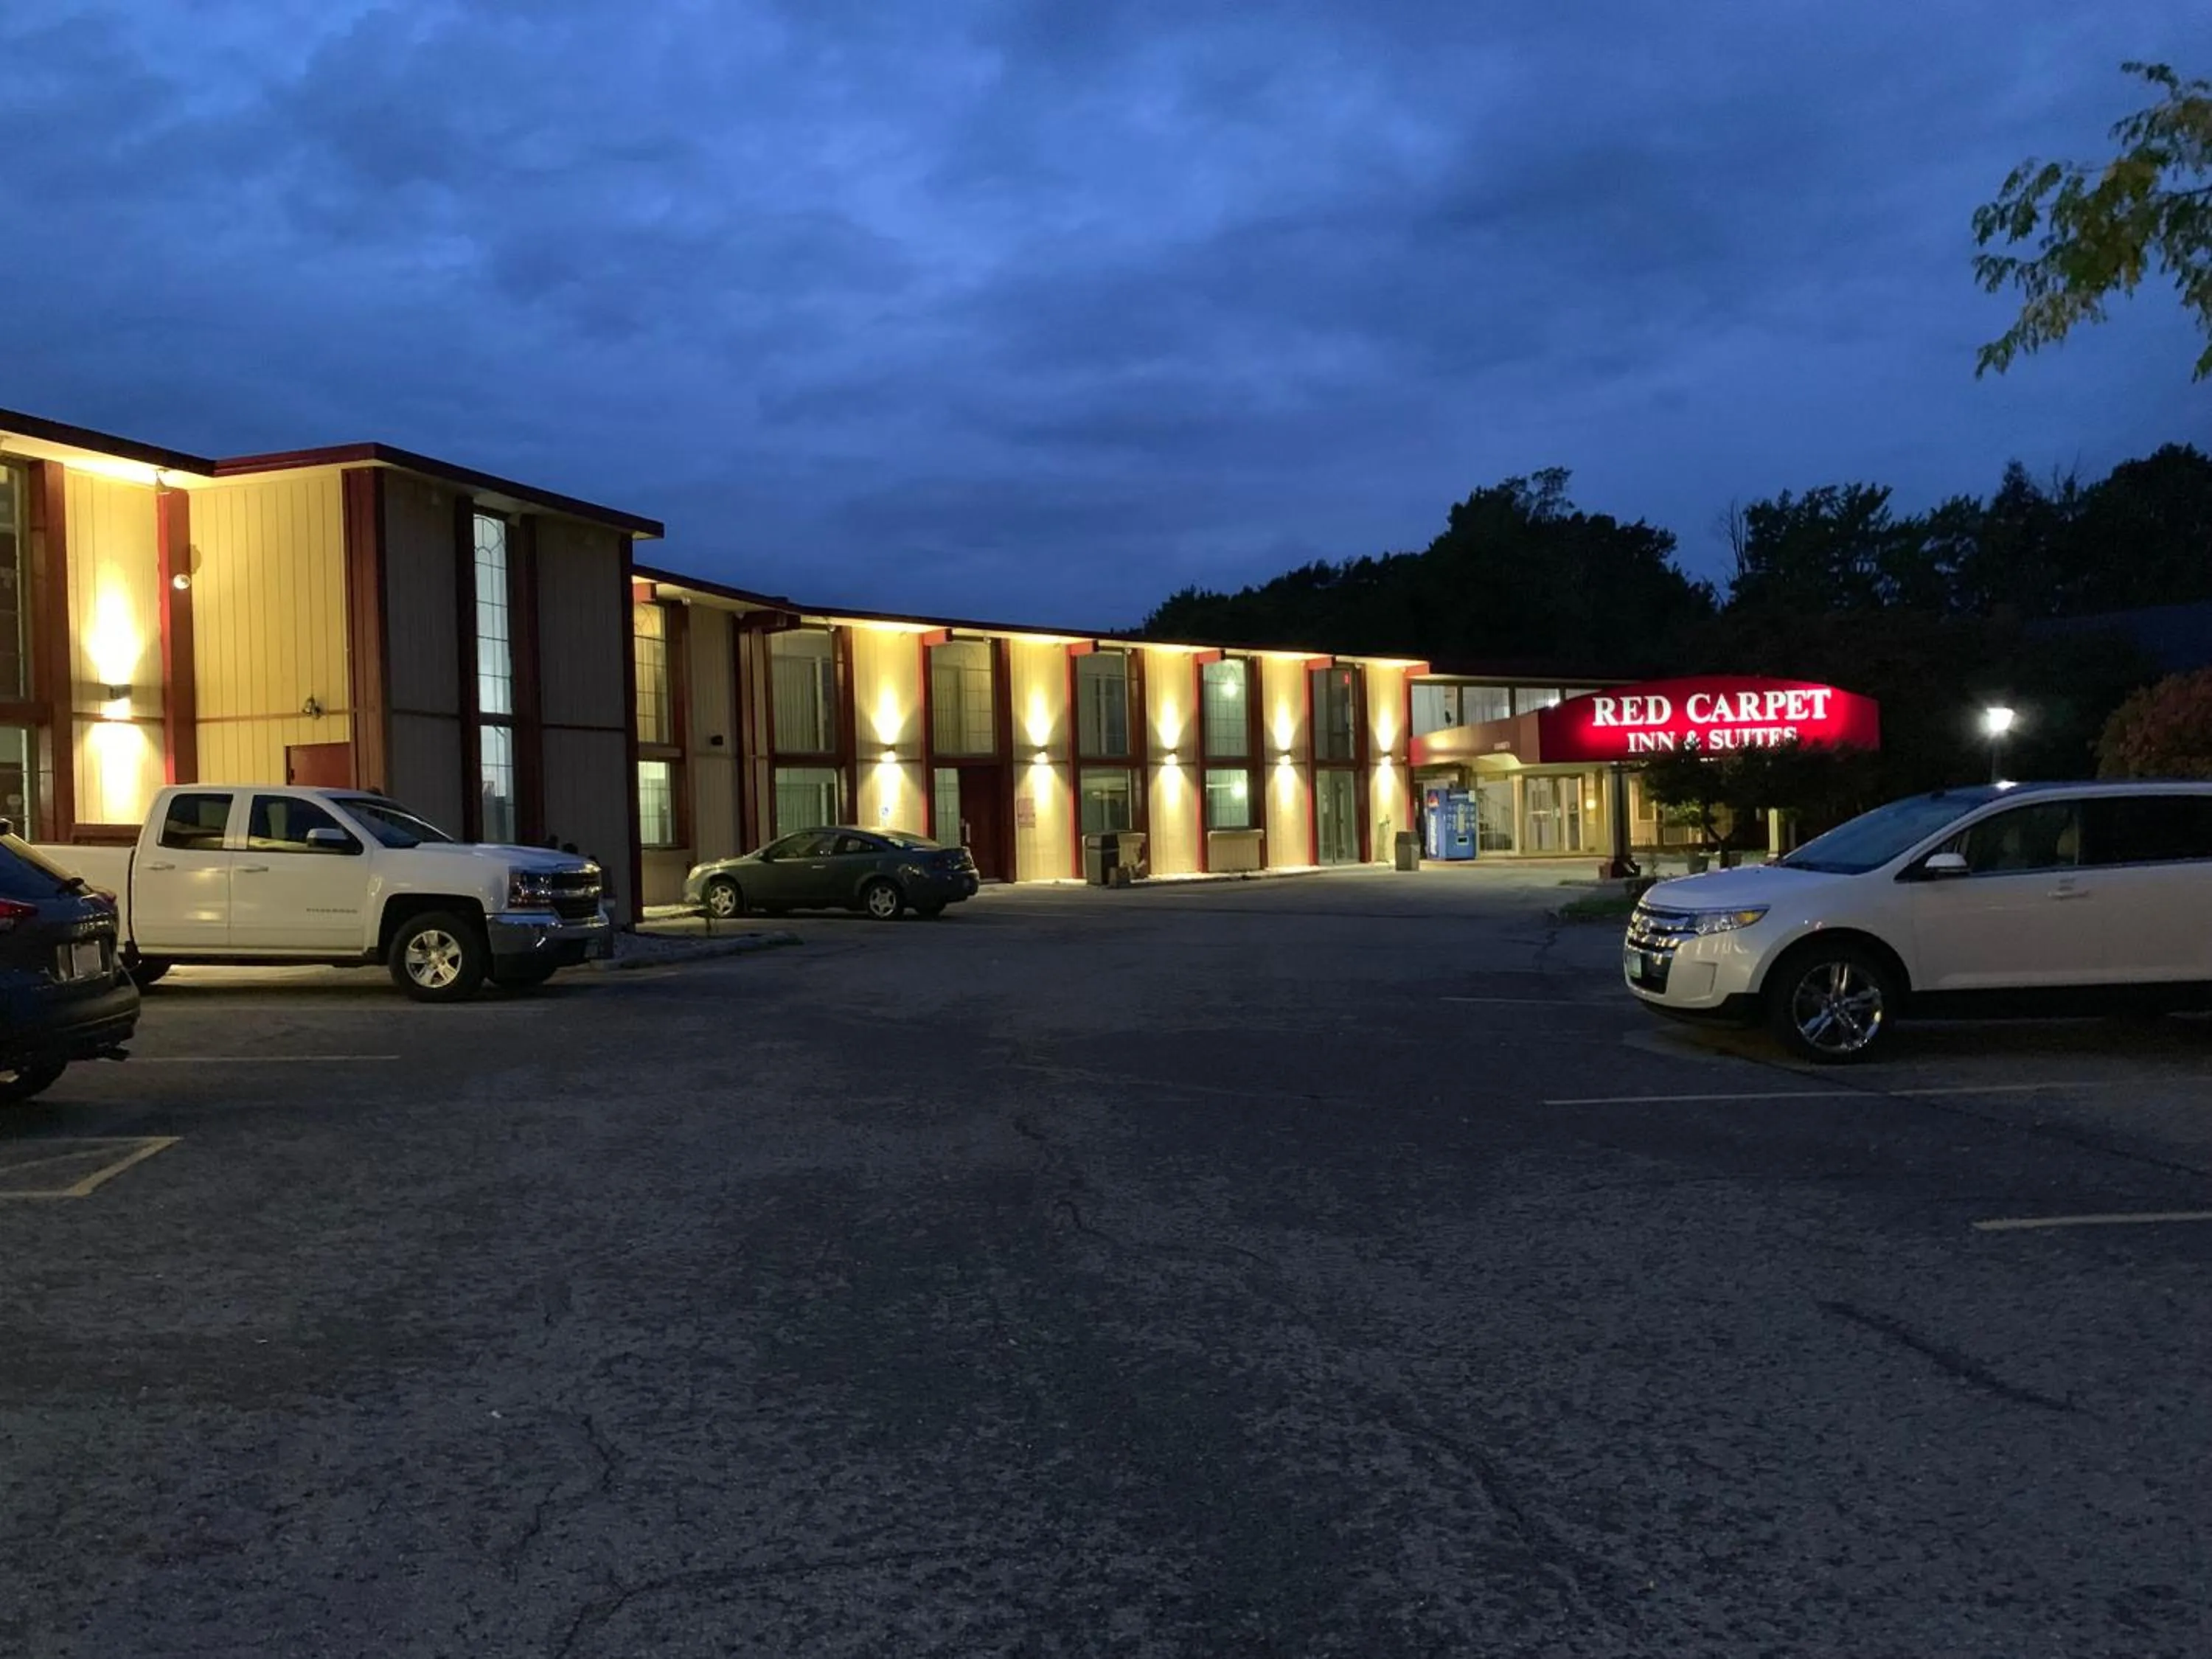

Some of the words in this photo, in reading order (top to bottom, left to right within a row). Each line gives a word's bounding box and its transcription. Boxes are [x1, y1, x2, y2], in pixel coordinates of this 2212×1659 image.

[1593, 695, 1672, 726] RED
[1686, 689, 1832, 724] CARPET
[1627, 731, 1676, 752] INN
[1683, 729, 1701, 751] &
